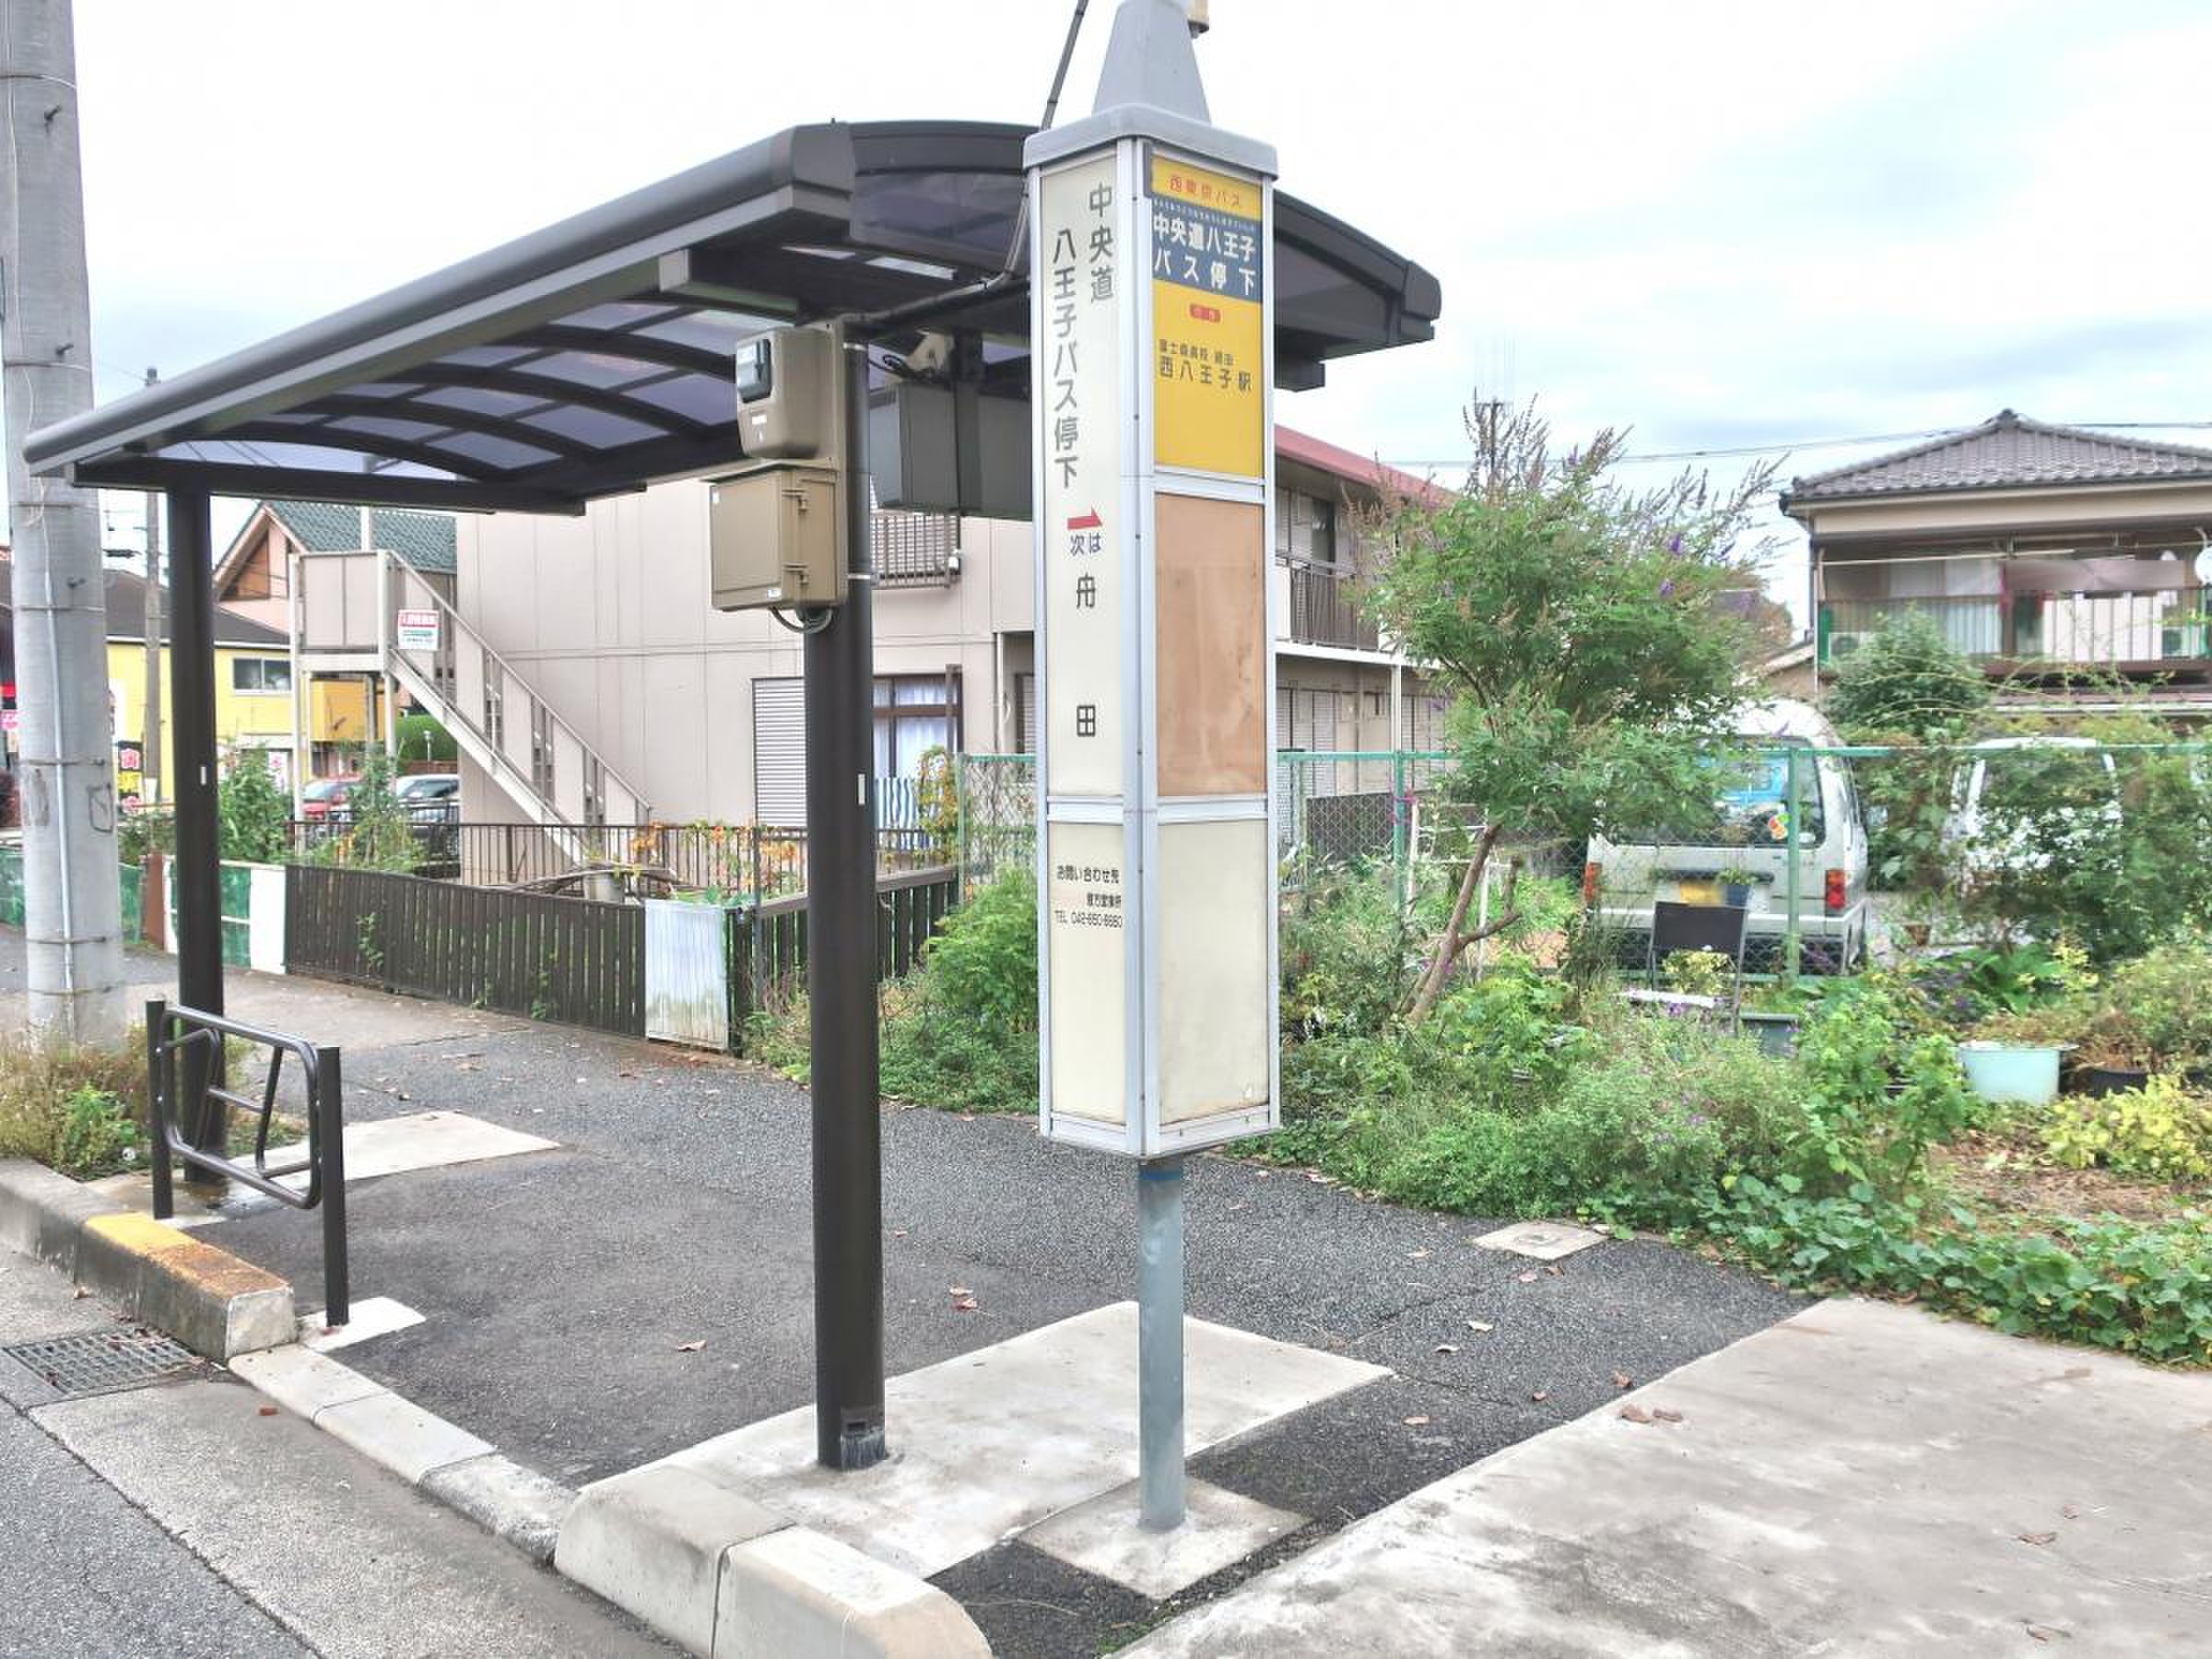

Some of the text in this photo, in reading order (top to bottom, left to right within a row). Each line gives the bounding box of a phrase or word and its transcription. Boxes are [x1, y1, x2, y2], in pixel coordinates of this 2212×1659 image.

[1089, 183, 1113, 304] 中央道
[1153, 212, 1256, 262] 中央道八王子
[1154, 248, 1256, 296] バス停下
[1053, 229, 1079, 488] 八王子バス停下
[1159, 355, 1253, 392] 西八王子駅
[1070, 534, 1101, 555] 次は
[1077, 572, 1096, 737] 舟田
